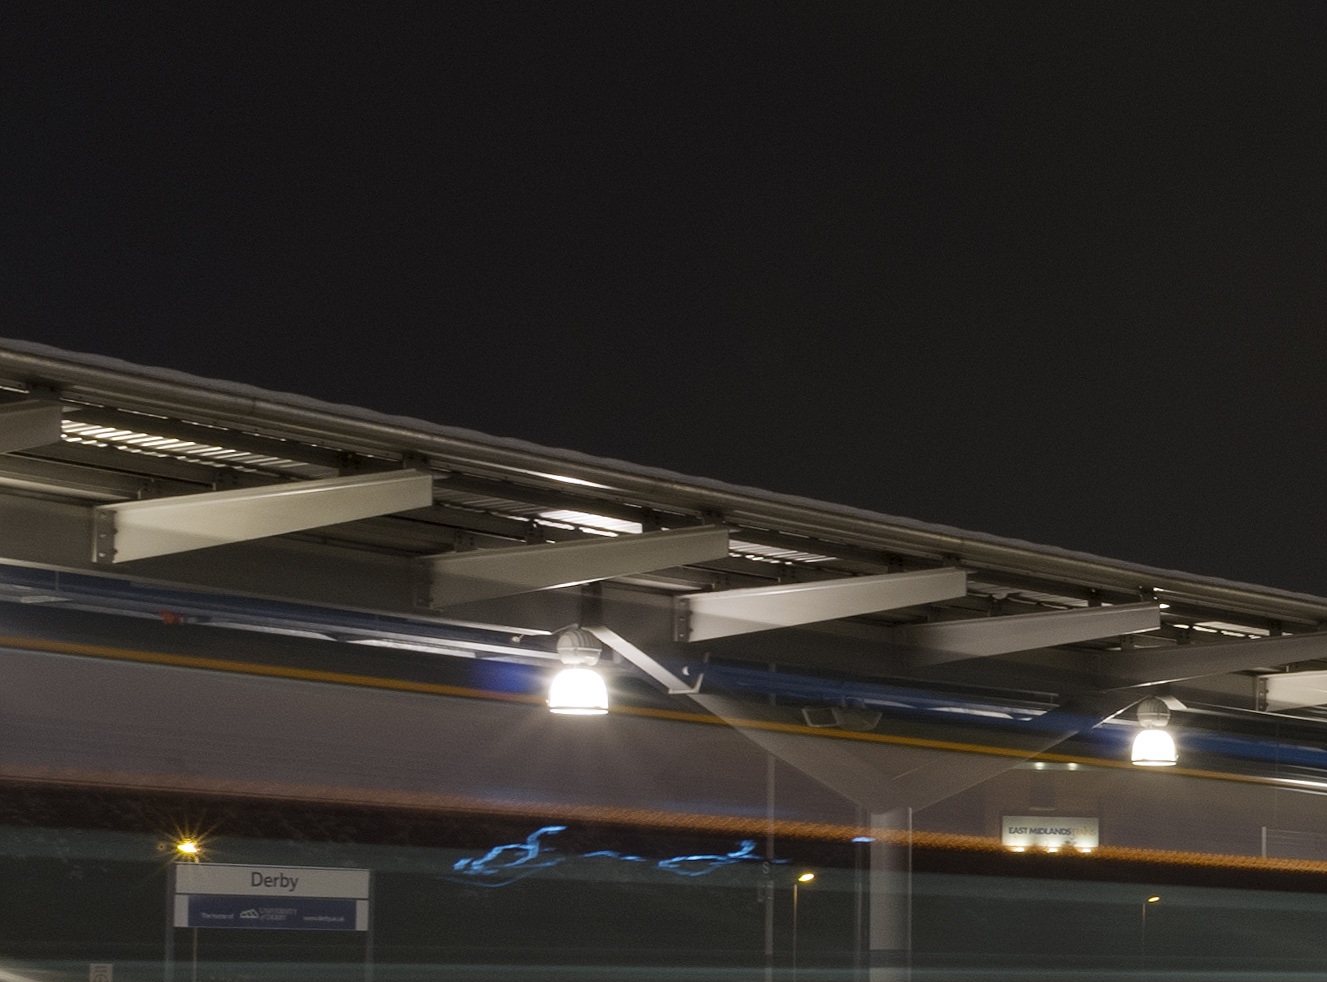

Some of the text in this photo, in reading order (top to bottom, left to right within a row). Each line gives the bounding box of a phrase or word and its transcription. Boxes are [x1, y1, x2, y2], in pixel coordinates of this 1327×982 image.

[1008, 826, 1028, 834] EAST
[1029, 827, 1072, 835] MIDLANDS
[251, 872, 299, 892] Derby
